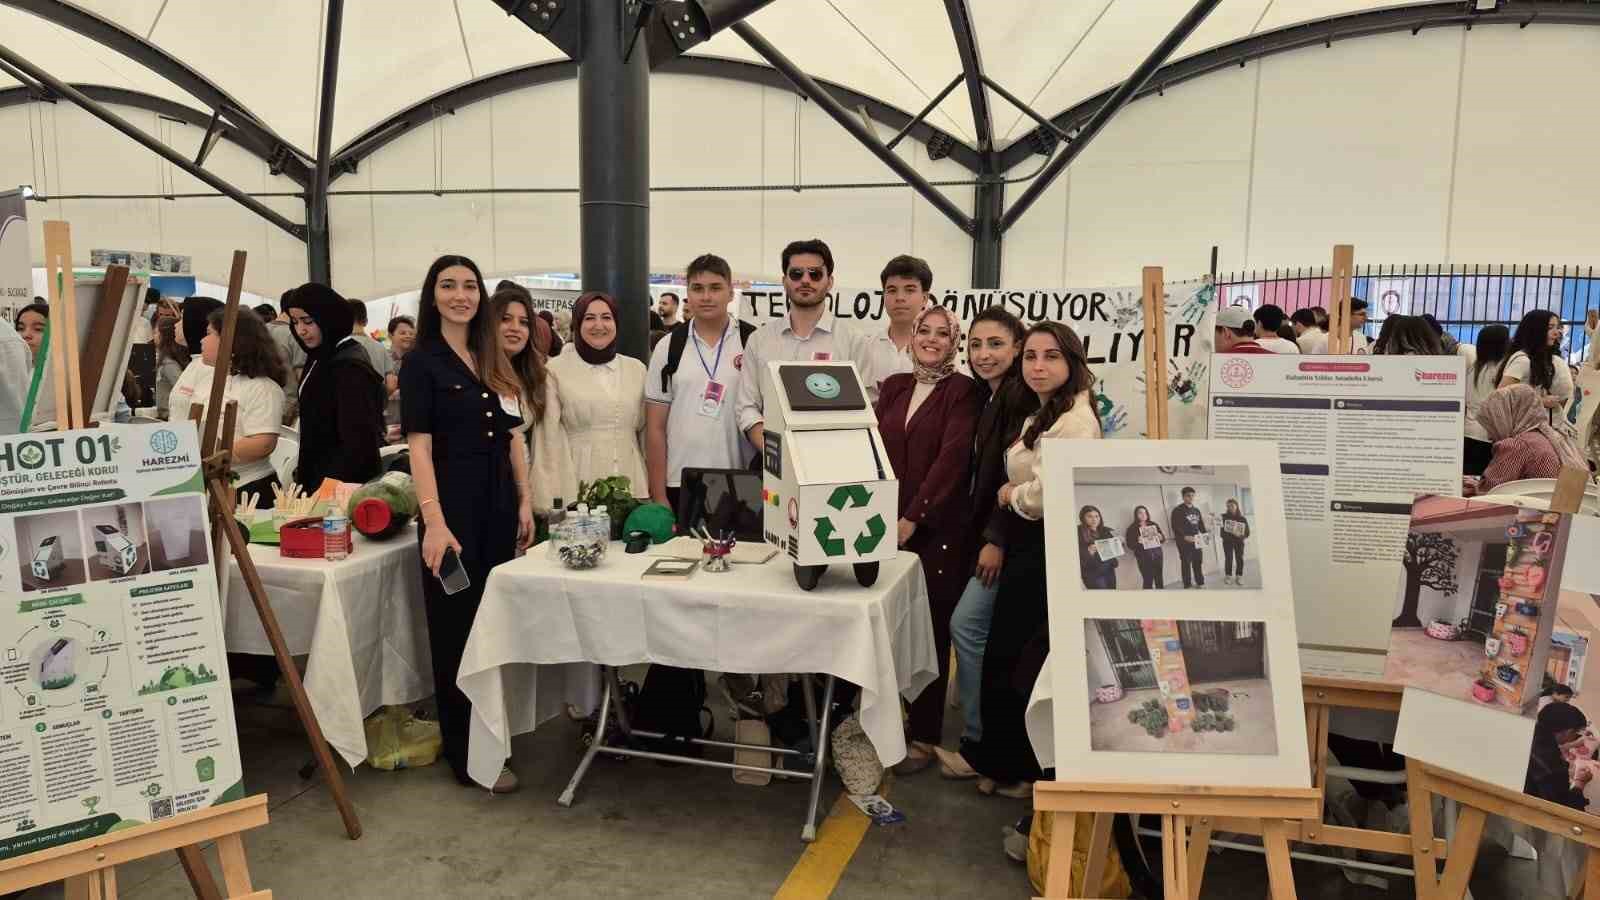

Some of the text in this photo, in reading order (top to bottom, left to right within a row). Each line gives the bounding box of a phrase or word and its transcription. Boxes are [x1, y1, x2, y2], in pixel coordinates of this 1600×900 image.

[75, 434, 112, 464] 01
[142, 454, 190, 467] HAREZMİ
[36, 465, 85, 482] GELECEĞİ
[88, 463, 119, 477] KORU!
